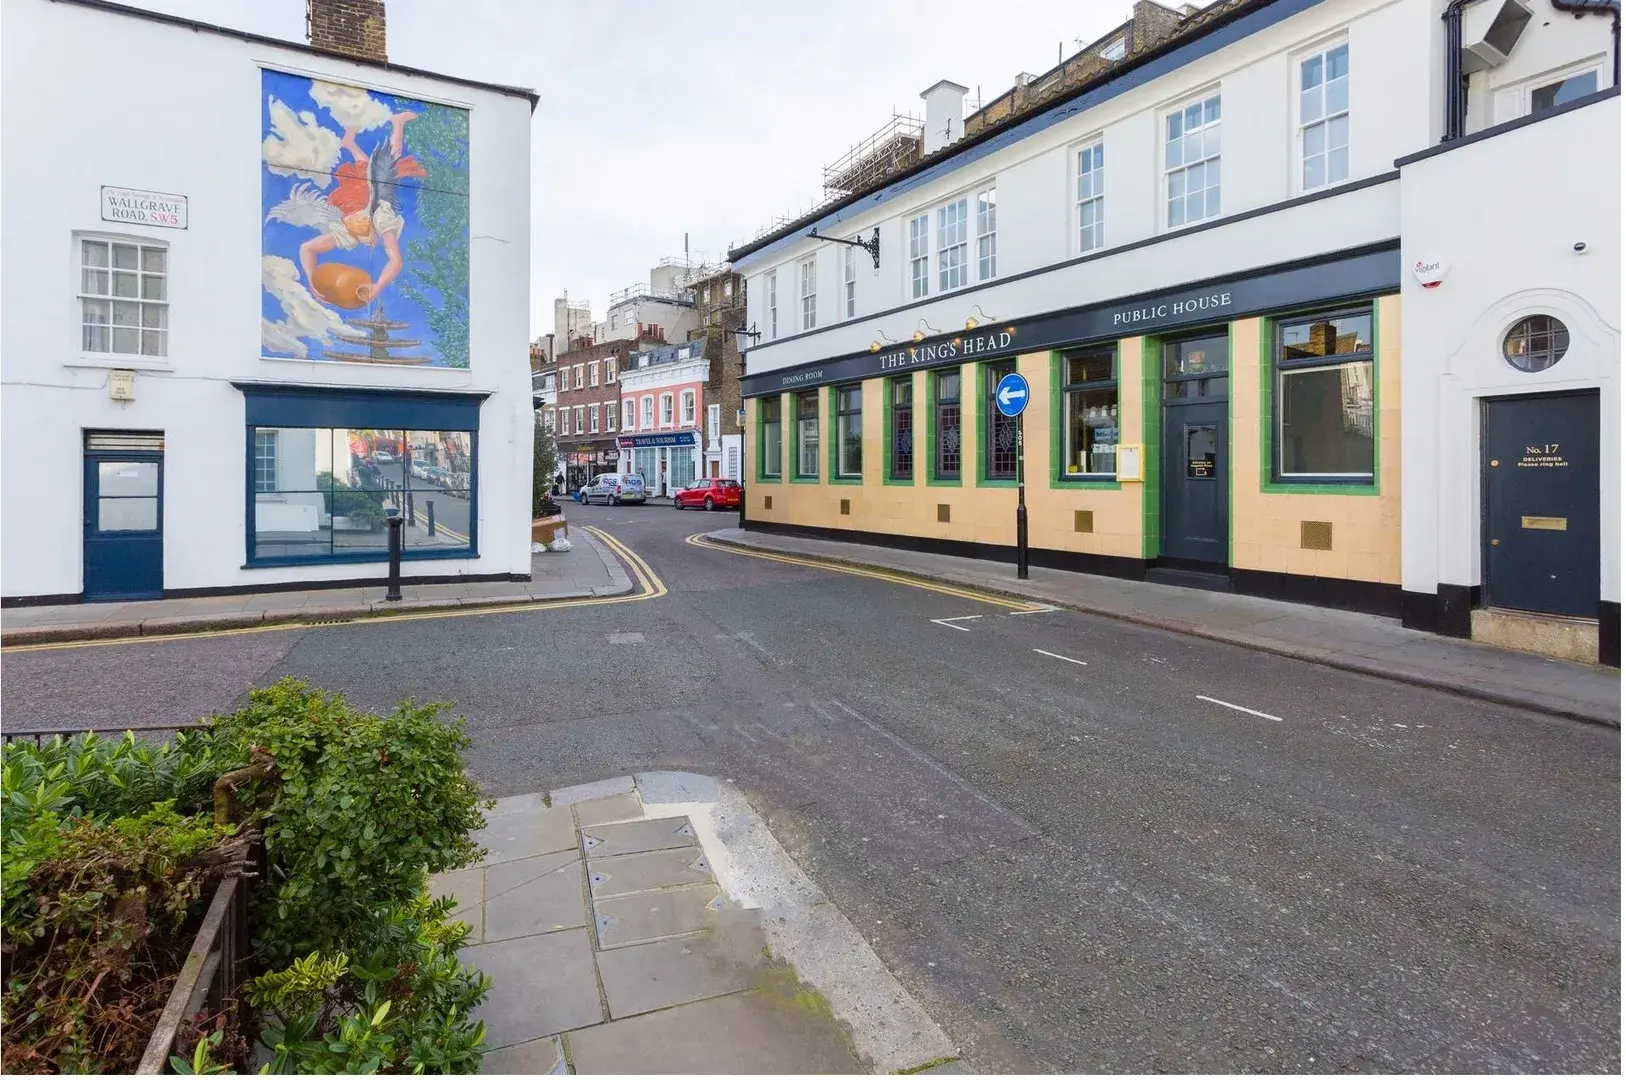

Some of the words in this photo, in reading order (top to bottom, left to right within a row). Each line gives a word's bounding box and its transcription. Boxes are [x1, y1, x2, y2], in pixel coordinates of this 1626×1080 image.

[108, 196, 180, 214] WALLGRAVE
[1113, 305, 1167, 325] PUBLIC
[1173, 293, 1232, 315] HOUSE
[880, 352, 906, 369] THE
[911, 341, 956, 364] KING'S
[963, 332, 1011, 355] HEAD
[782, 374, 804, 385] DINING
[805, 370, 823, 381] ROOM
[1545, 444, 1559, 454] 17
